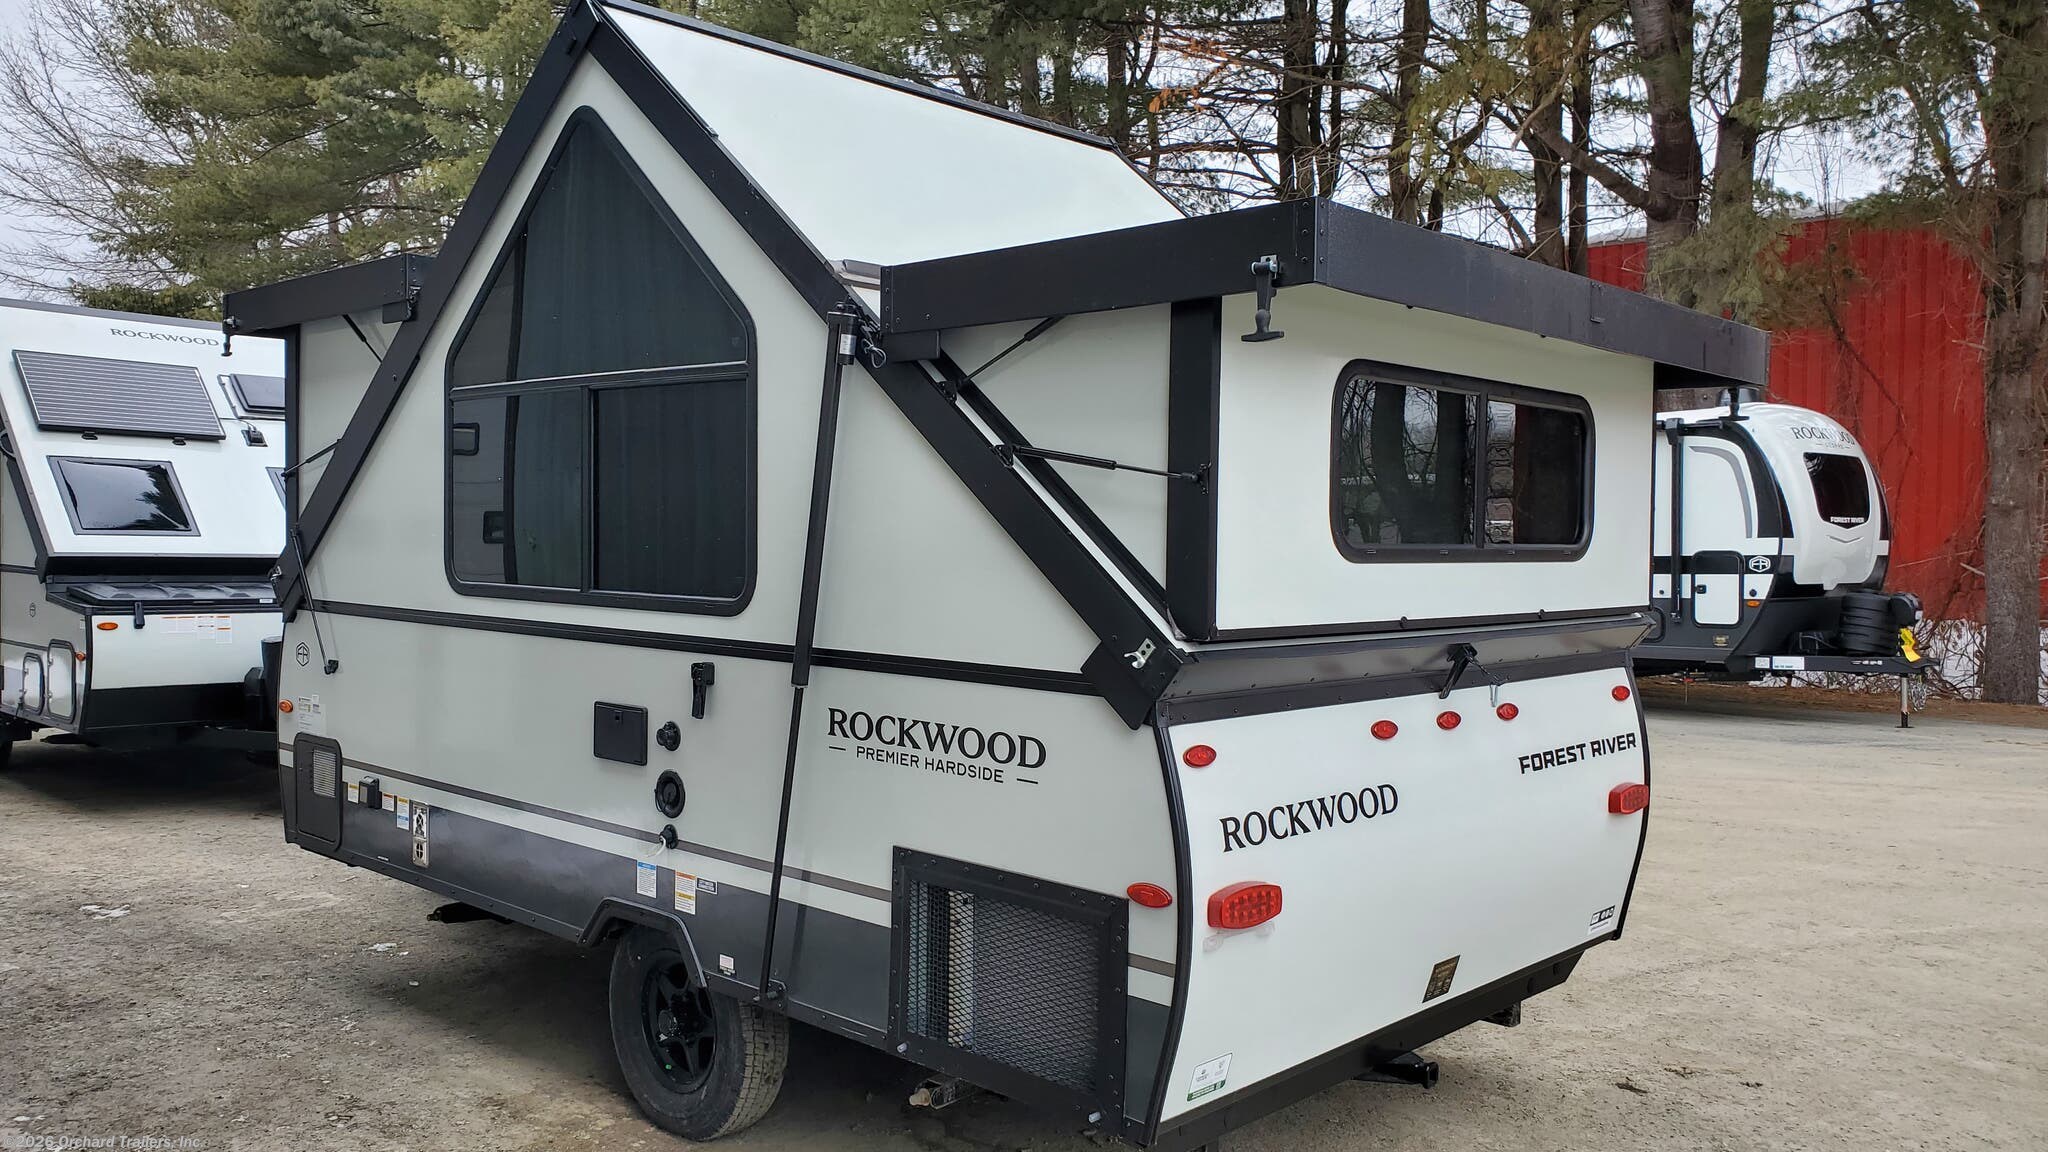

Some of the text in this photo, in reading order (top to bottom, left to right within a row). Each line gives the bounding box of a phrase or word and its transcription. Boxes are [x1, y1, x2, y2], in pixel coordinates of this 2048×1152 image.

[110, 328, 220, 346] ROCKWOOD
[827, 707, 1048, 770] ROCKWOOD
[1518, 731, 1638, 775] FOREST RIVER
[856, 746, 1005, 784] PREMIER HARDSIDE
[1219, 783, 1400, 853] ROCKWOOD
